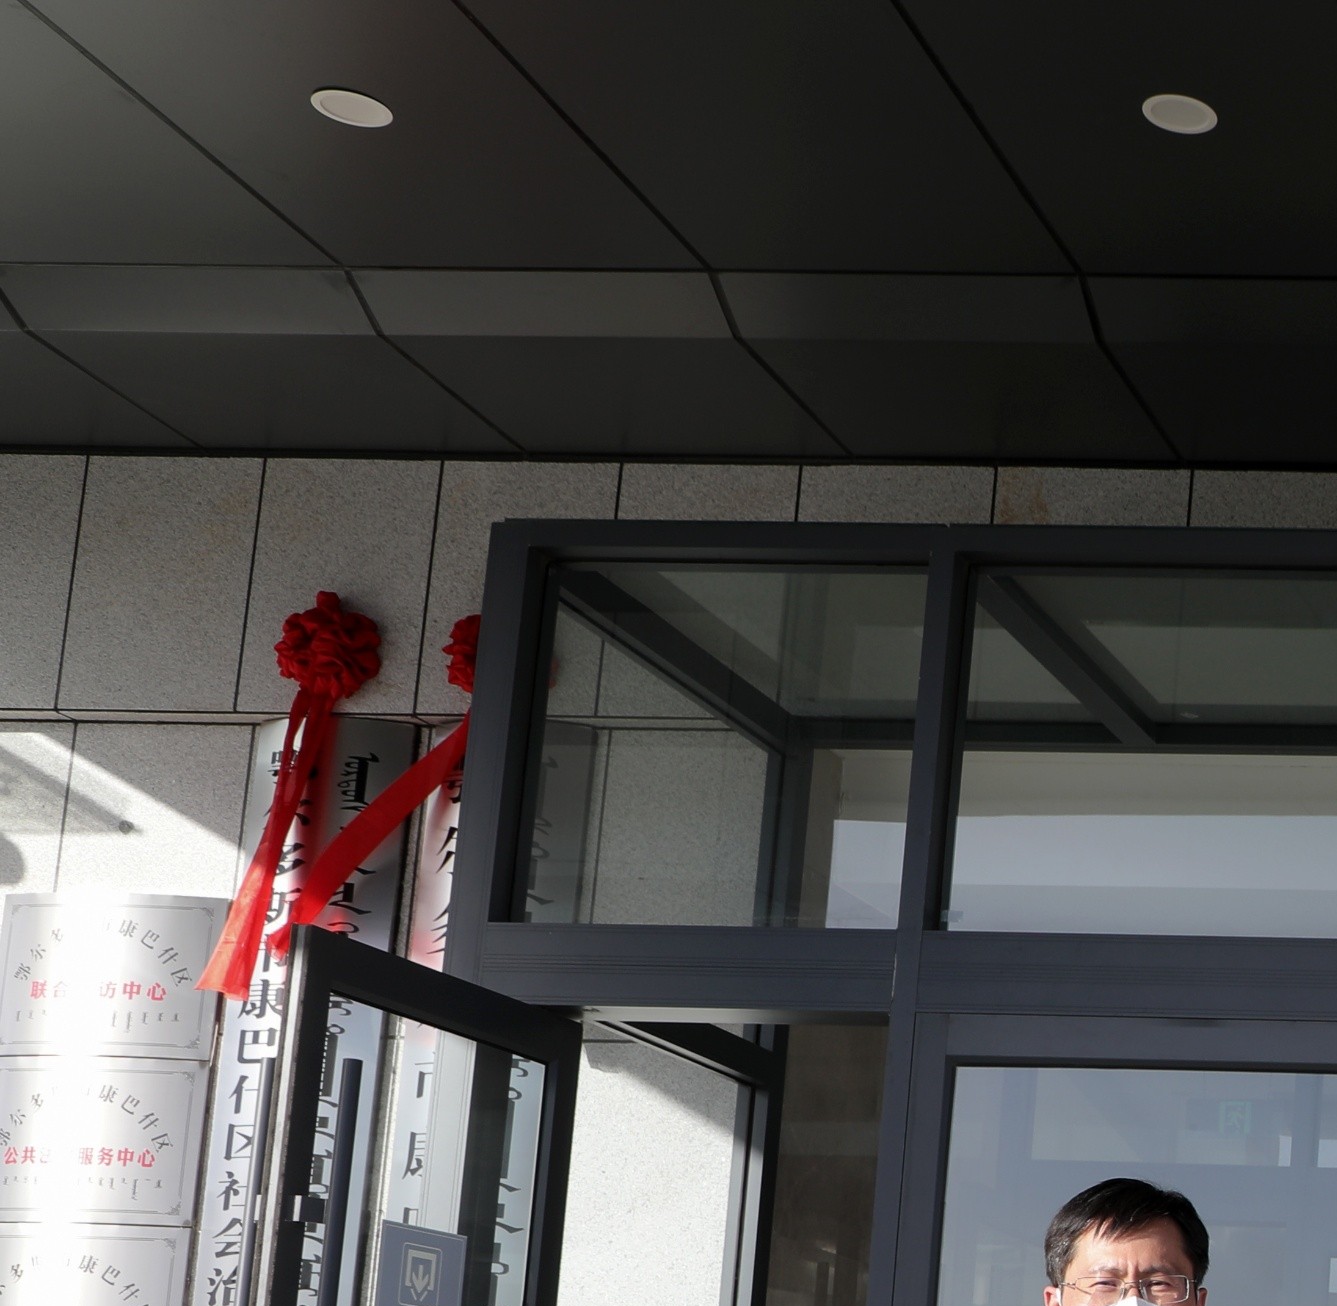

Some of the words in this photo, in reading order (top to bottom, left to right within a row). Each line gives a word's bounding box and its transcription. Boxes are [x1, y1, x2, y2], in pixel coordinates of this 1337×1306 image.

[29, 980, 167, 1001] 联合访中心
